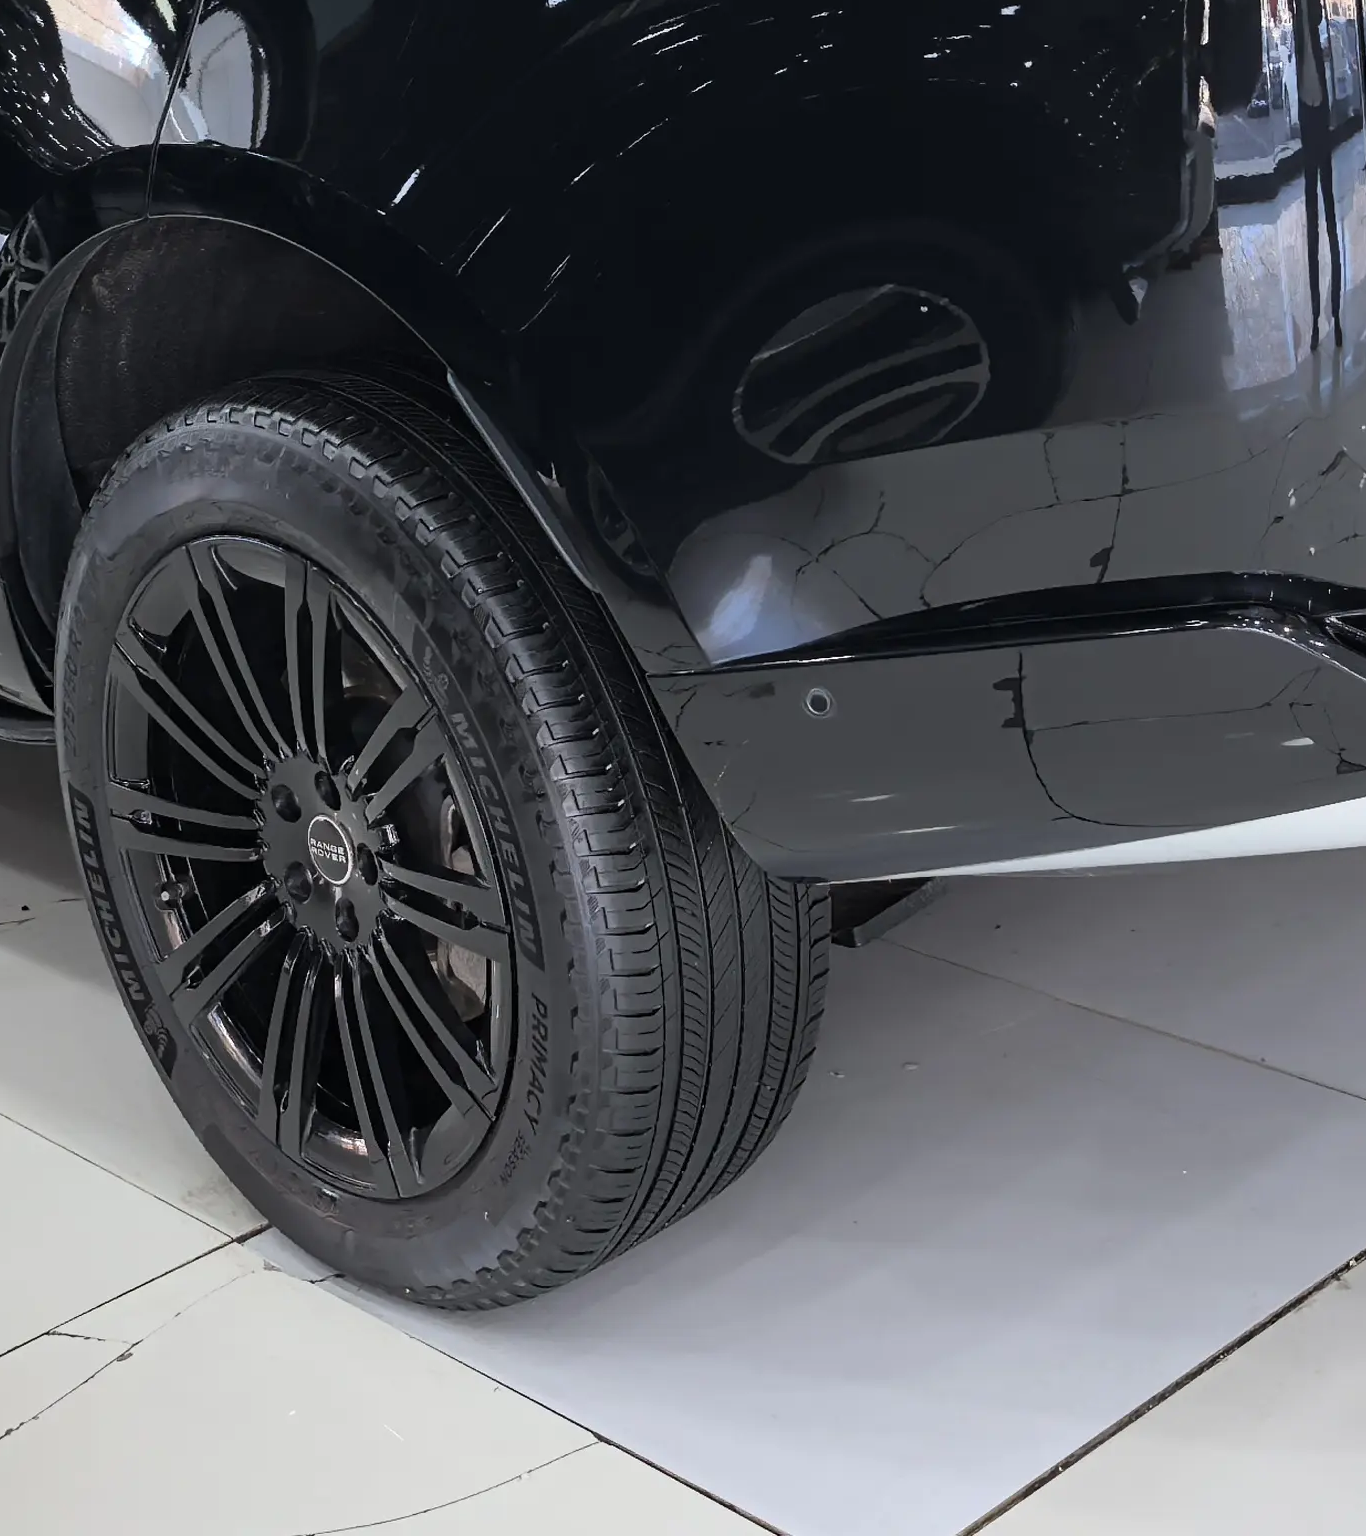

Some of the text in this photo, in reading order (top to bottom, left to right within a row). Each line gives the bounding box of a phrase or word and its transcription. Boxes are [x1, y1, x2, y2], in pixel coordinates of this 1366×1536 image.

[72, 796, 145, 1002] MICHELIN
[310, 837, 345, 855] RANGE
[310, 845, 347, 864] ROVER
[451, 712, 537, 946] MICHELIN
[524, 992, 549, 1136] PRIMACY
